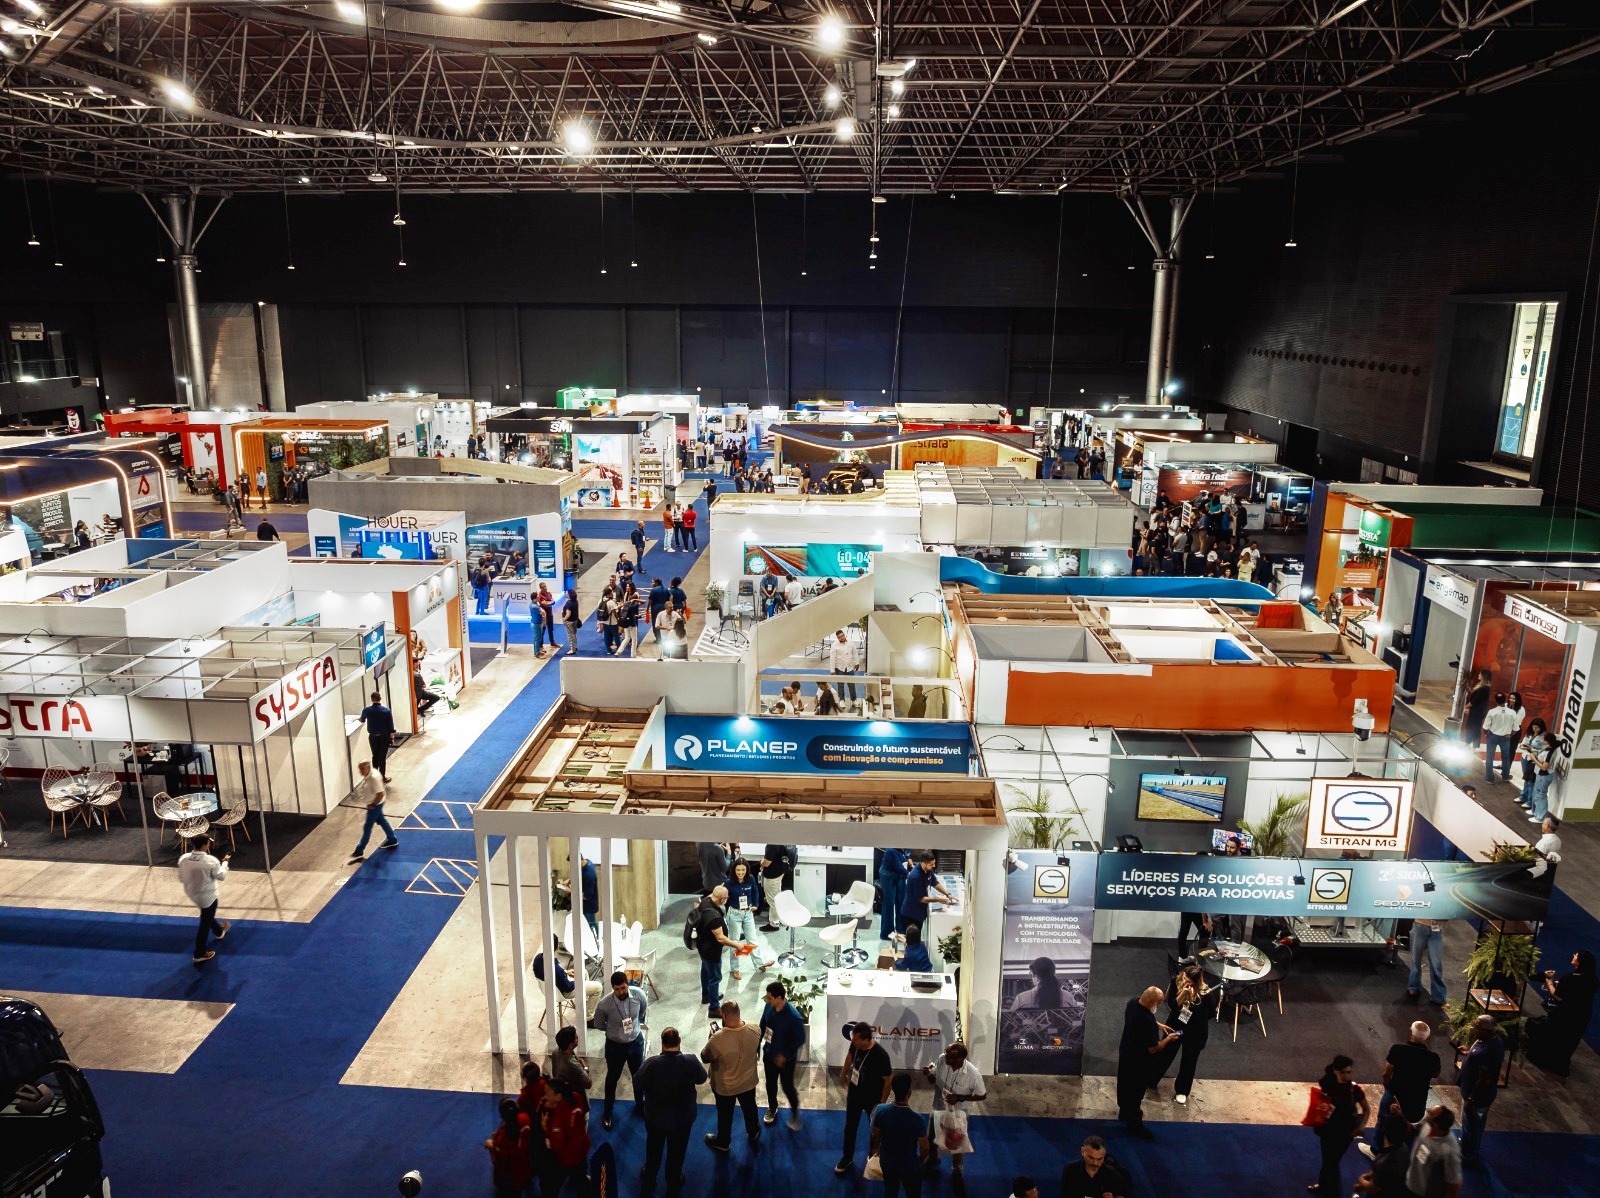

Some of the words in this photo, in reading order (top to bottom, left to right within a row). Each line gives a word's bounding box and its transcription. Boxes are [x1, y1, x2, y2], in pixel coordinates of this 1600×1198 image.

[41, 499, 62, 508] JUNTOS
[366, 515, 419, 530] HOUER
[496, 591, 528, 601] HUER
[1436, 581, 1470, 606] engemap
[255, 655, 337, 731] SYSTRA
[1560, 668, 1586, 759] emam
[707, 739, 798, 754] PLANEP
[823, 743, 874, 752] Construindo
[882, 744, 909, 753] futuro
[910, 746, 962, 755] sustentável
[842, 754, 880, 764] inovação
[887, 756, 944, 765] compromisso
[1320, 837, 1371, 847] SITRAN
[1375, 839, 1397, 847] MG
[1122, 868, 1180, 884] LÍDERES
[1183, 873, 1204, 884] EM
[1207, 873, 1284, 888] SOLUÇÕES
[1397, 870, 1435, 881] SIGMA
[1106, 884, 1176, 899] SERVIÇOS
[1179, 886, 1218, 898] PARA
[1221, 888, 1295, 900] RODOVIAS
[870, 1025, 941, 1037] PLANEP
